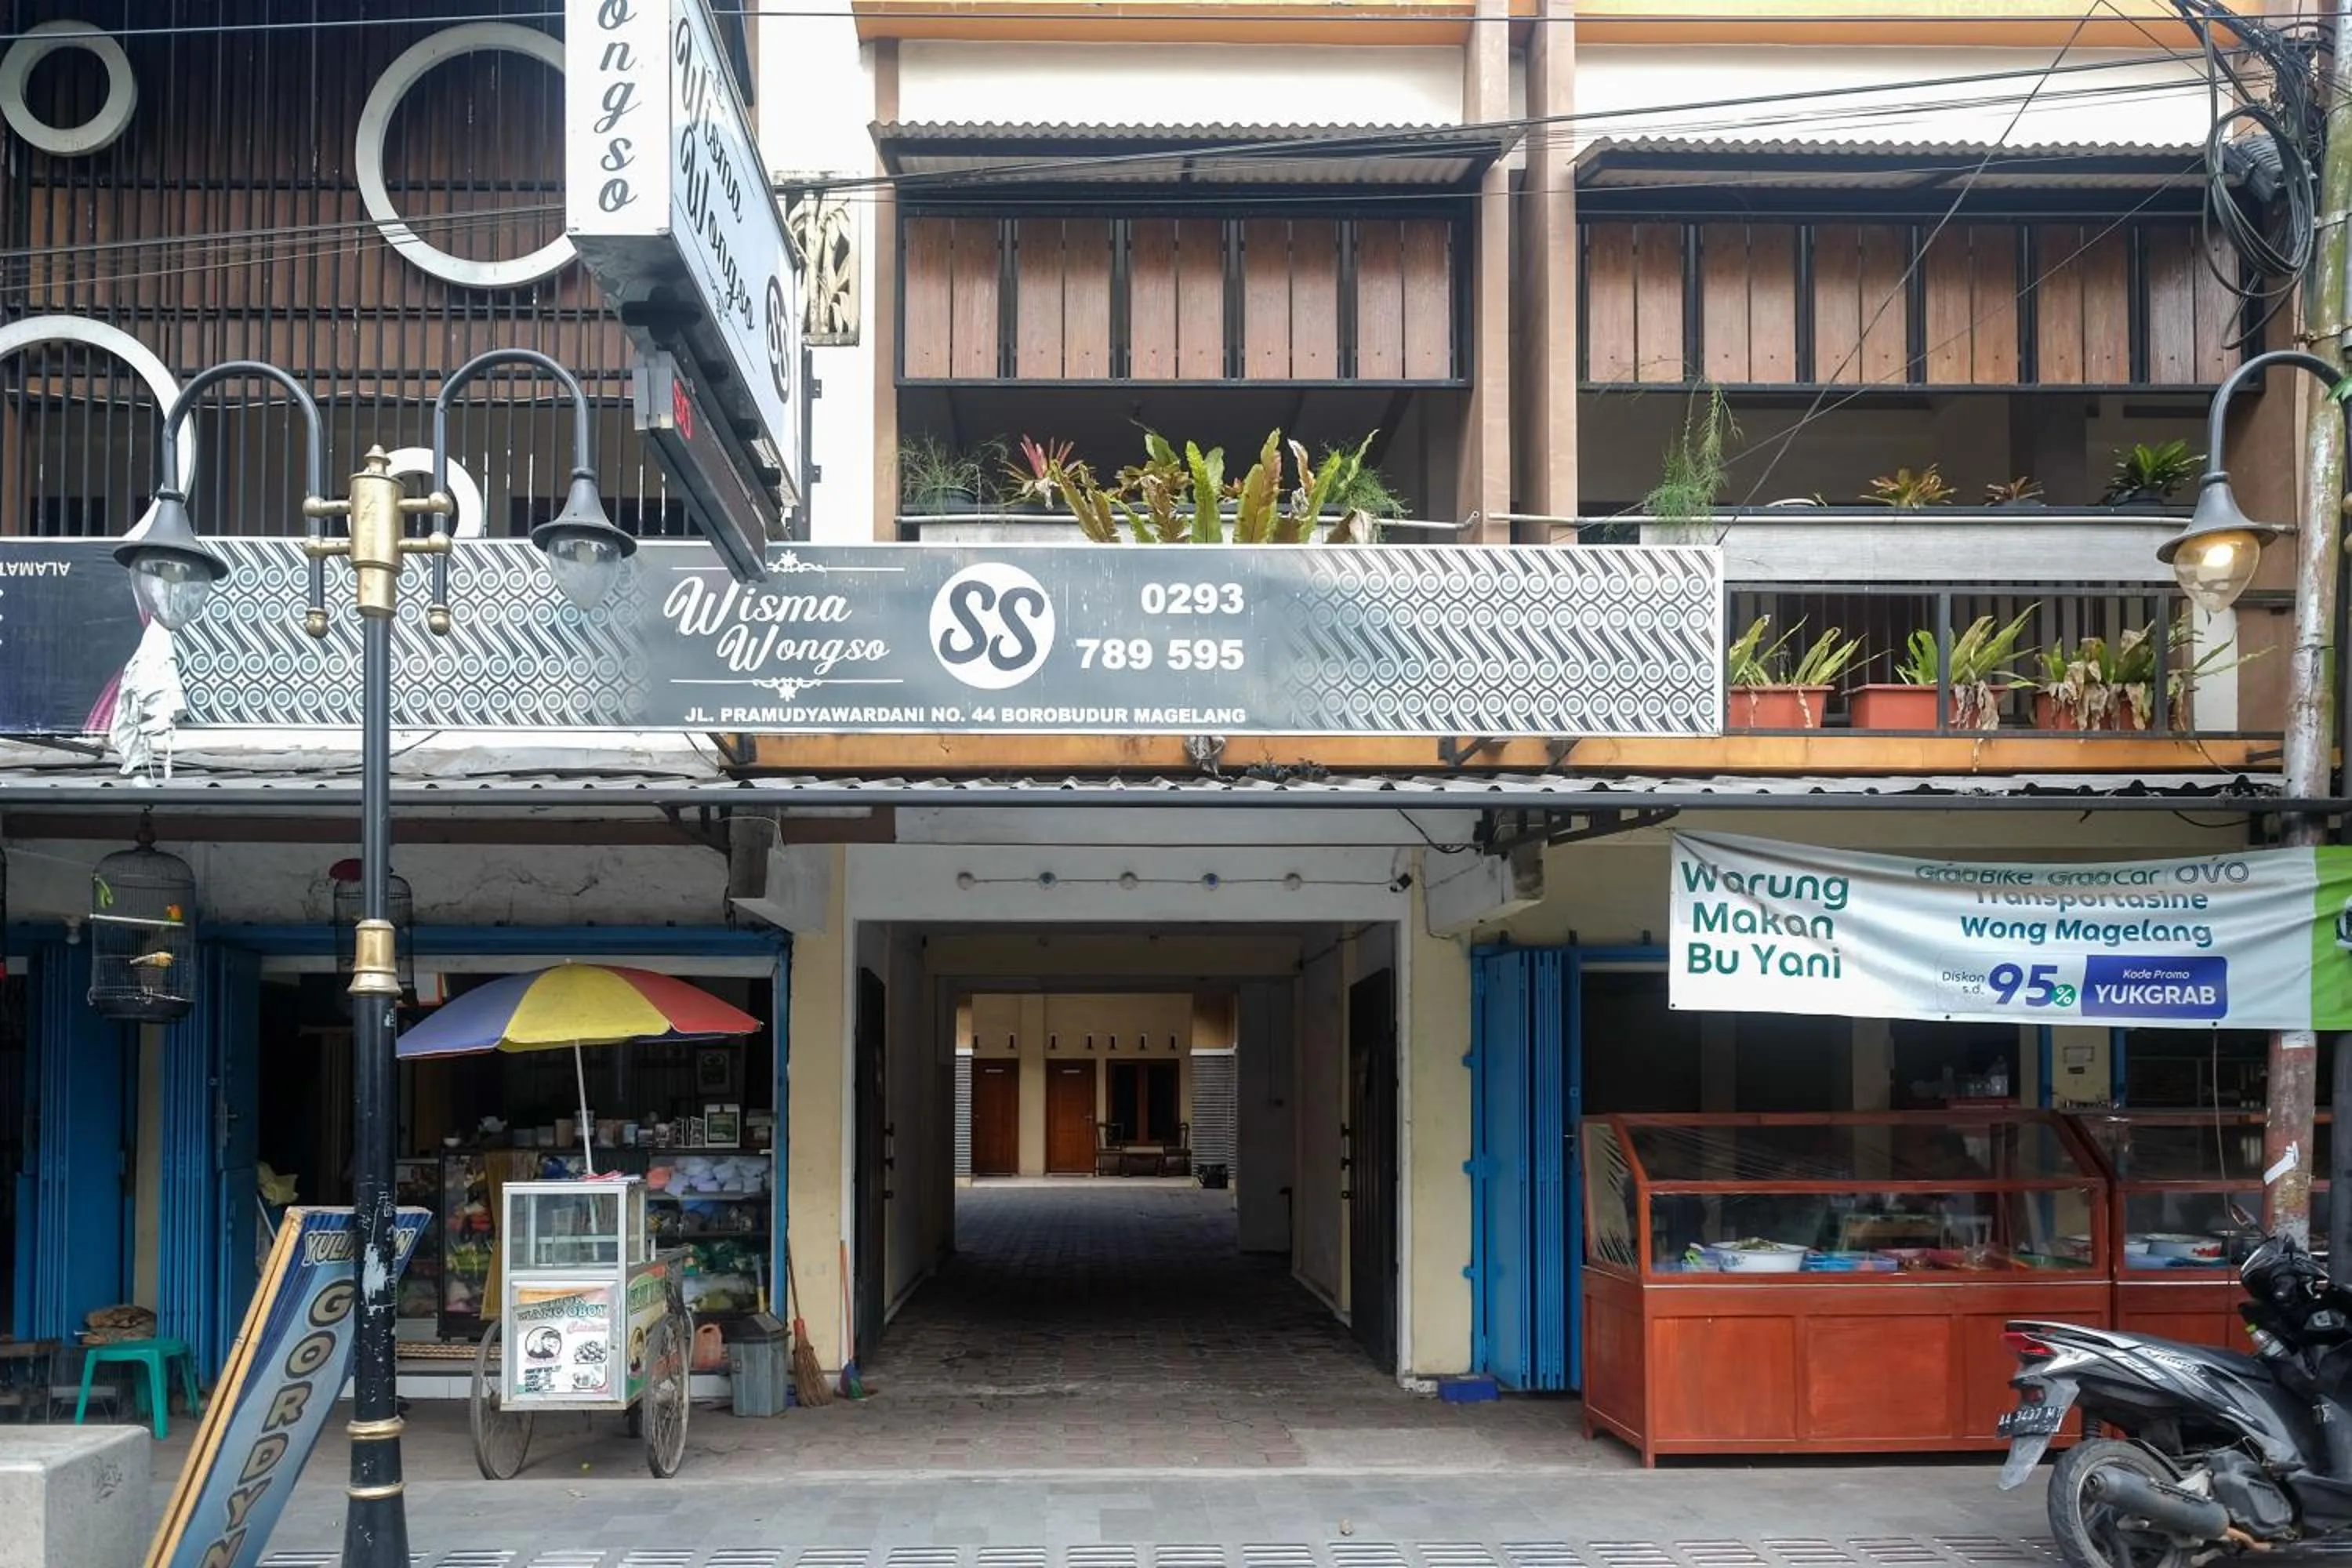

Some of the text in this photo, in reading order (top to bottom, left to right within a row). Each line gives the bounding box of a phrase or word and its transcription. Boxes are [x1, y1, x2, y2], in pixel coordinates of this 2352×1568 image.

[675, 17, 742, 223] Wisma
[680, 124, 755, 330] Wongso
[662, 575, 852, 636] Wisma
[1141, 583, 1245, 614] 0293
[939, 580, 1045, 671] SS
[716, 622, 890, 675] Wongso
[1076, 638, 1245, 670] 789 595
[684, 707, 1246, 724] JL. PRAMUDYAWARDANI NO. 44 BOROBUDUR MAGELANG
[1680, 861, 1849, 910] Warung
[1976, 889, 2209, 913] Transportasine
[1693, 902, 1834, 939] Makan
[1960, 916, 2212, 948] Wong Magelang
[1687, 942, 1842, 979] Bu Yani
[1942, 971, 1986, 984] Diskon
[2122, 968, 2190, 980] Kode Promo
[2094, 984, 2217, 1006] YUKGRAB
